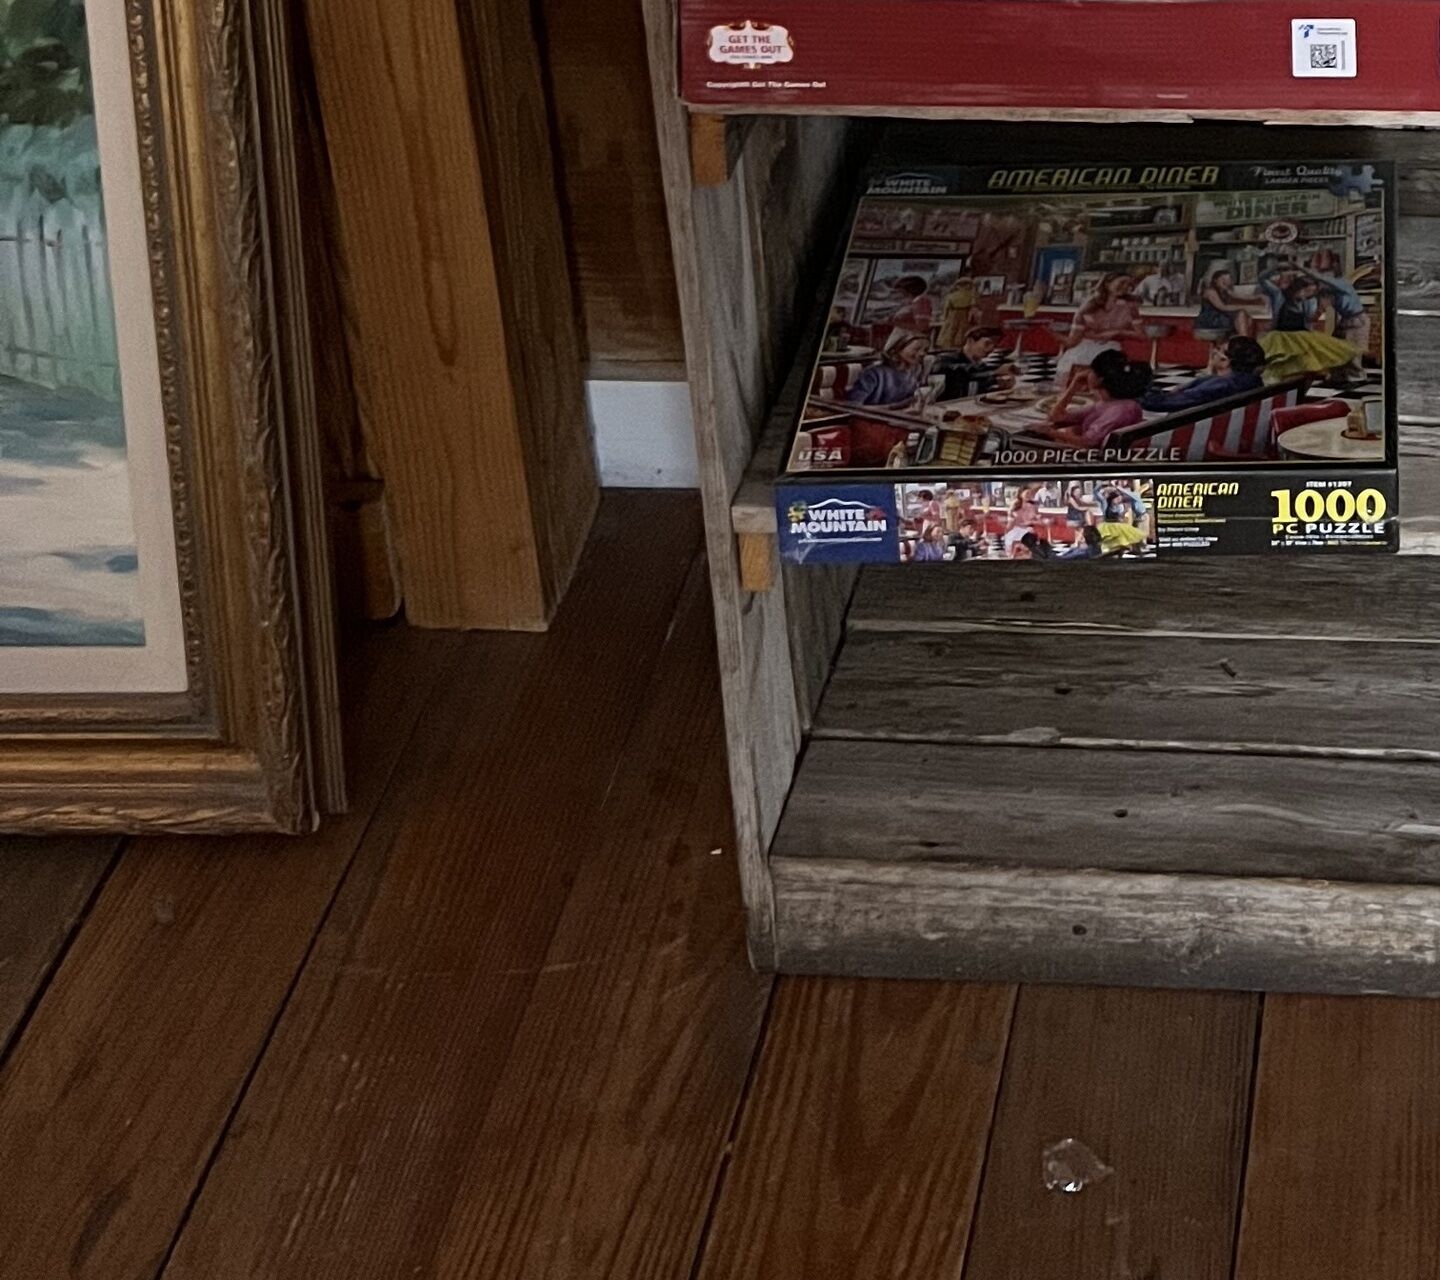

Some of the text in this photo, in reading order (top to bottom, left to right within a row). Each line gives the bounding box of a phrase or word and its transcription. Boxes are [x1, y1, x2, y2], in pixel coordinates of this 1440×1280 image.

[728, 35, 771, 44] GET THE
[720, 45, 782, 54] GAMES OUT
[1251, 165, 1344, 177] Finest Quality
[884, 179, 932, 187] WHITE
[987, 166, 1220, 189] AMERICAN DINER
[866, 186, 948, 194] MOUNTAIN
[1225, 201, 1309, 219] DINER
[799, 450, 843, 461] USA
[994, 447, 1182, 464] 1000 PIECE PUZZLE
[1157, 482, 1240, 496] AMERICAN
[1158, 496, 1204, 509] DINER
[1271, 488, 1387, 523] 1000
[808, 509, 865, 521] WHITE
[791, 520, 887, 534] MOUNTAIN
[1272, 522, 1386, 534] PC PUZZLE
